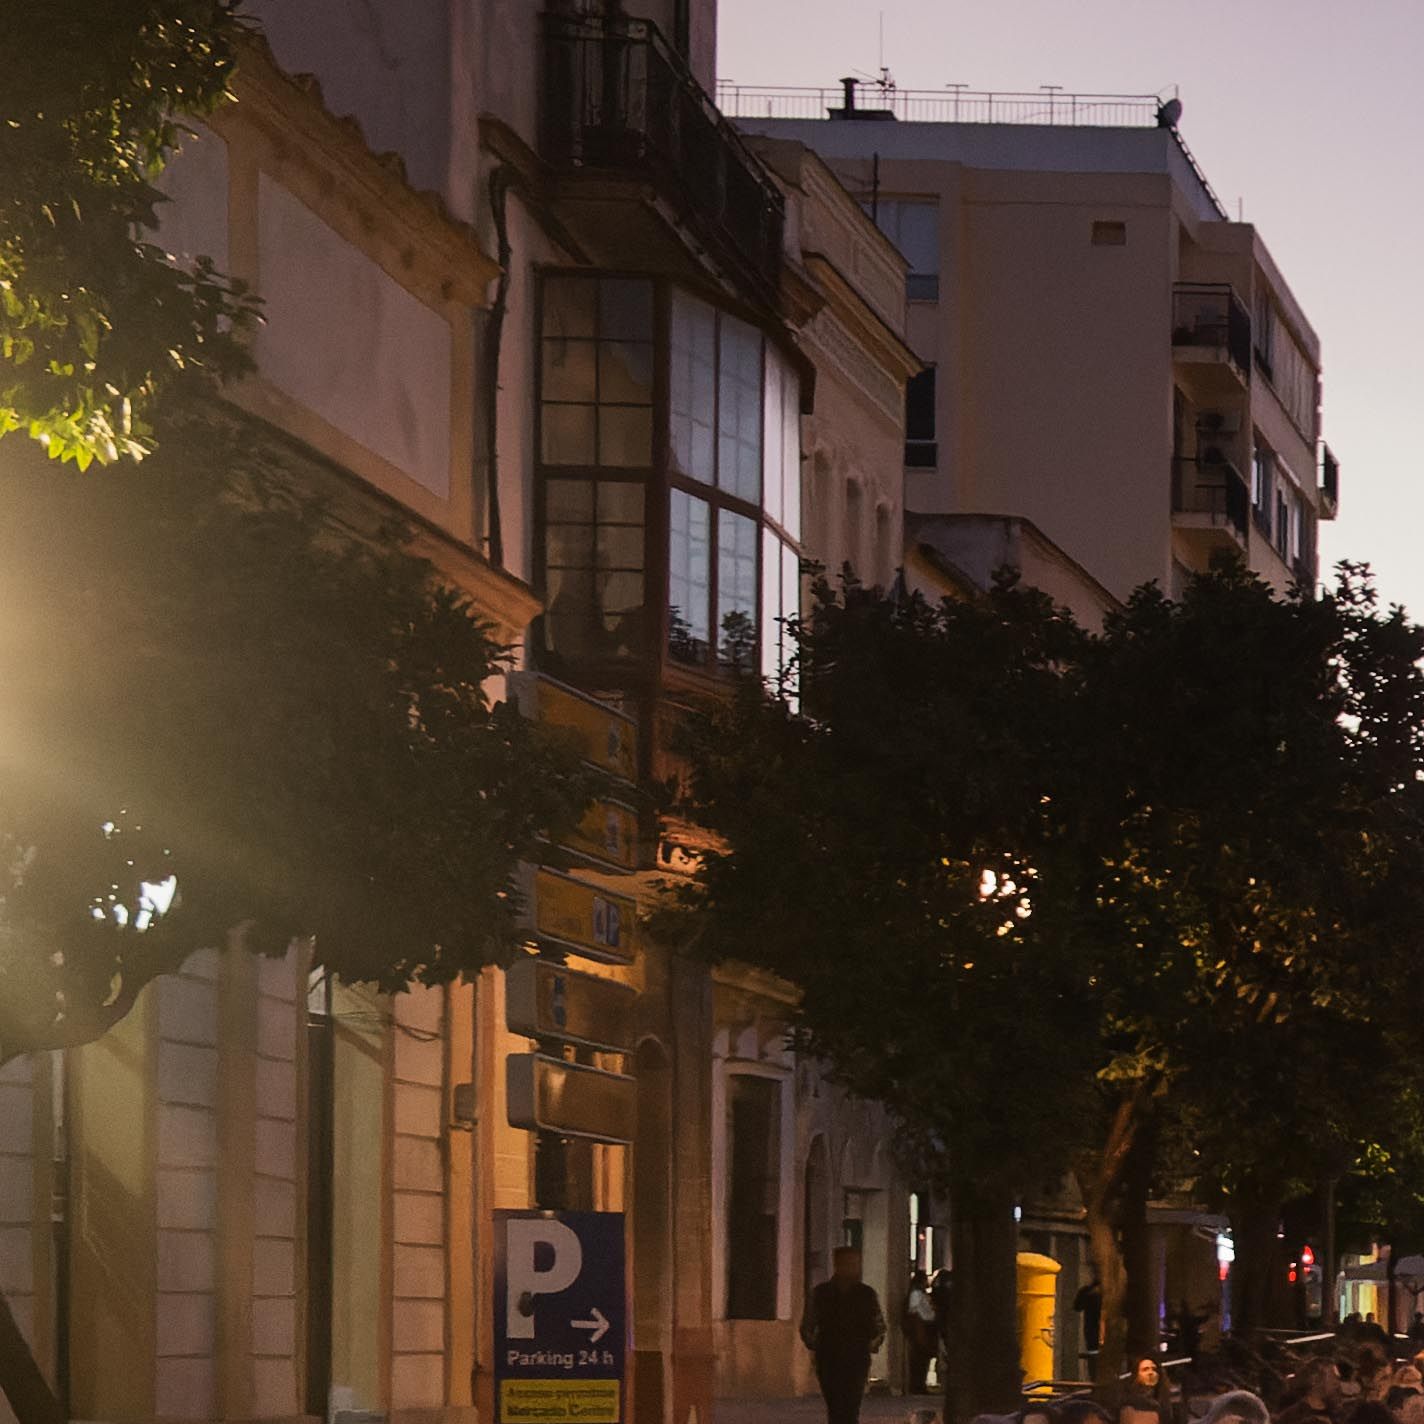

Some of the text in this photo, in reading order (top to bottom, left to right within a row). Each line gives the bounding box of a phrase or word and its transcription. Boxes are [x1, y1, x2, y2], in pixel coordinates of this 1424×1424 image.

[506, 1218, 583, 1339] P
[507, 1350, 614, 1369] Parking 24 h
